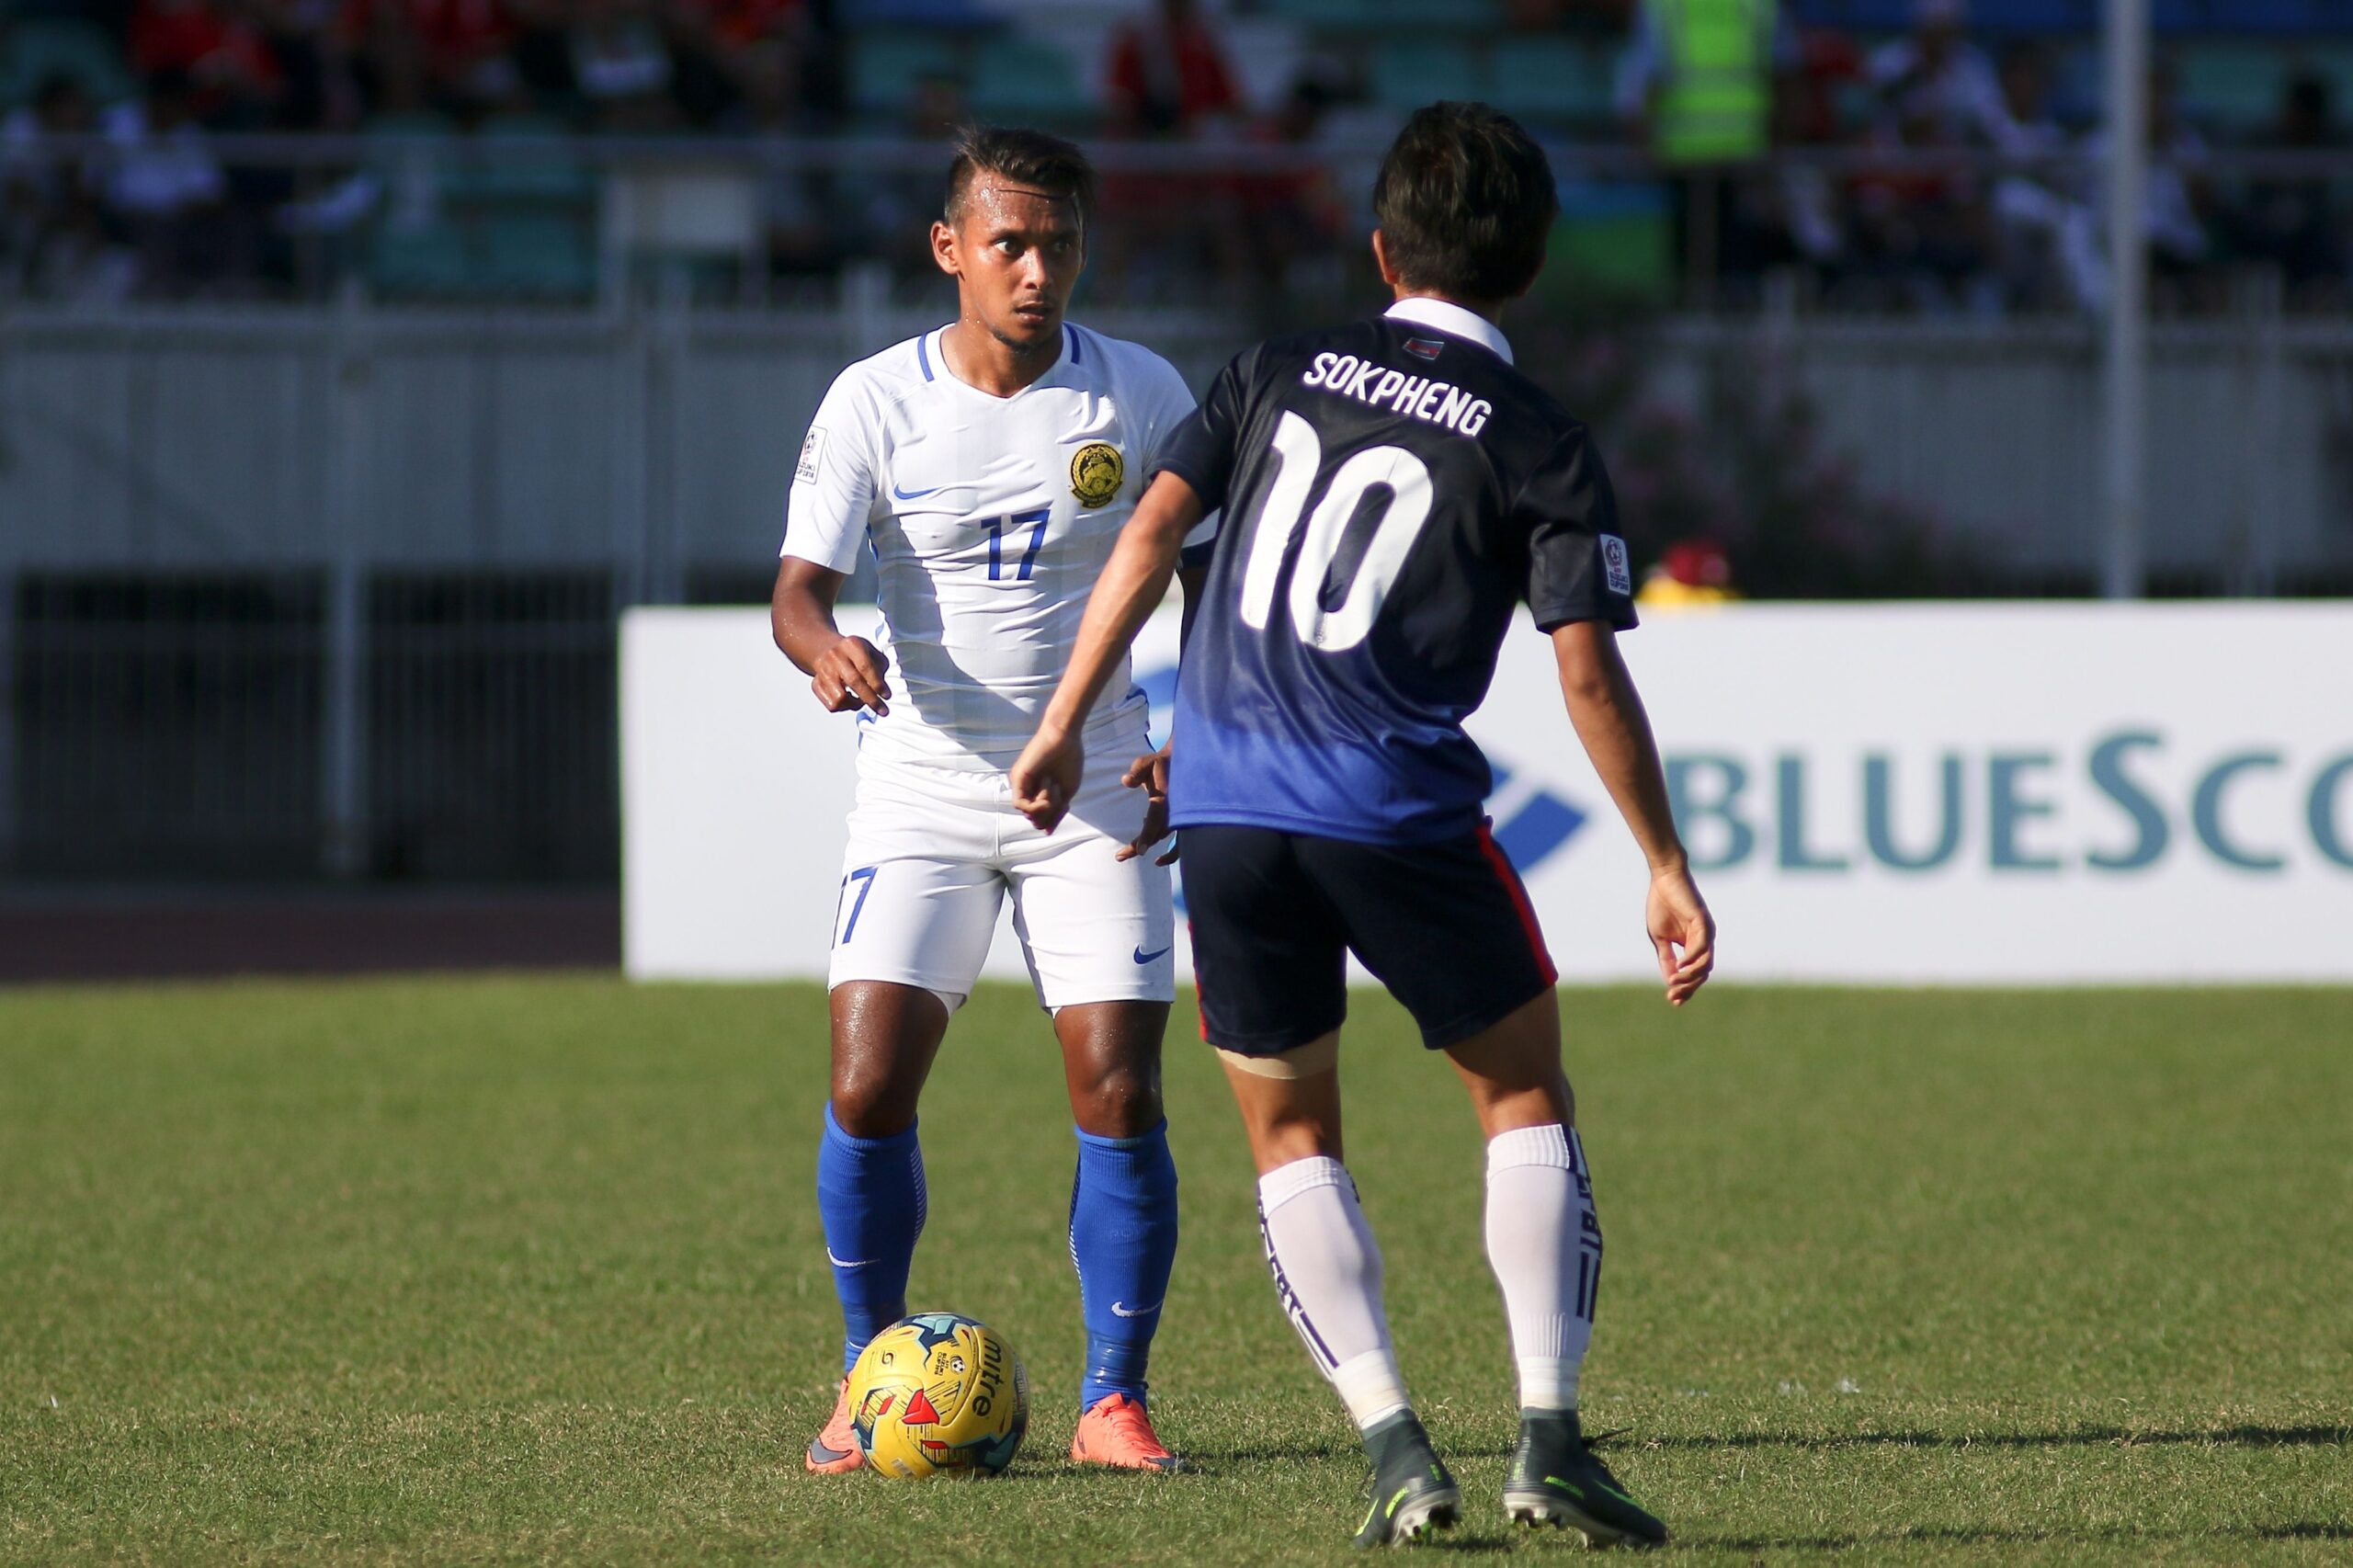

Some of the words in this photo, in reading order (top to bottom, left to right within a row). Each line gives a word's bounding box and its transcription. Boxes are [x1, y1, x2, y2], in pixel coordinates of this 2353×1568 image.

[1302, 351, 1493, 437] SOKPHENG
[981, 509, 1051, 582] 17
[1241, 410, 1434, 653] 10
[972, 1337, 1004, 1416] mitre
